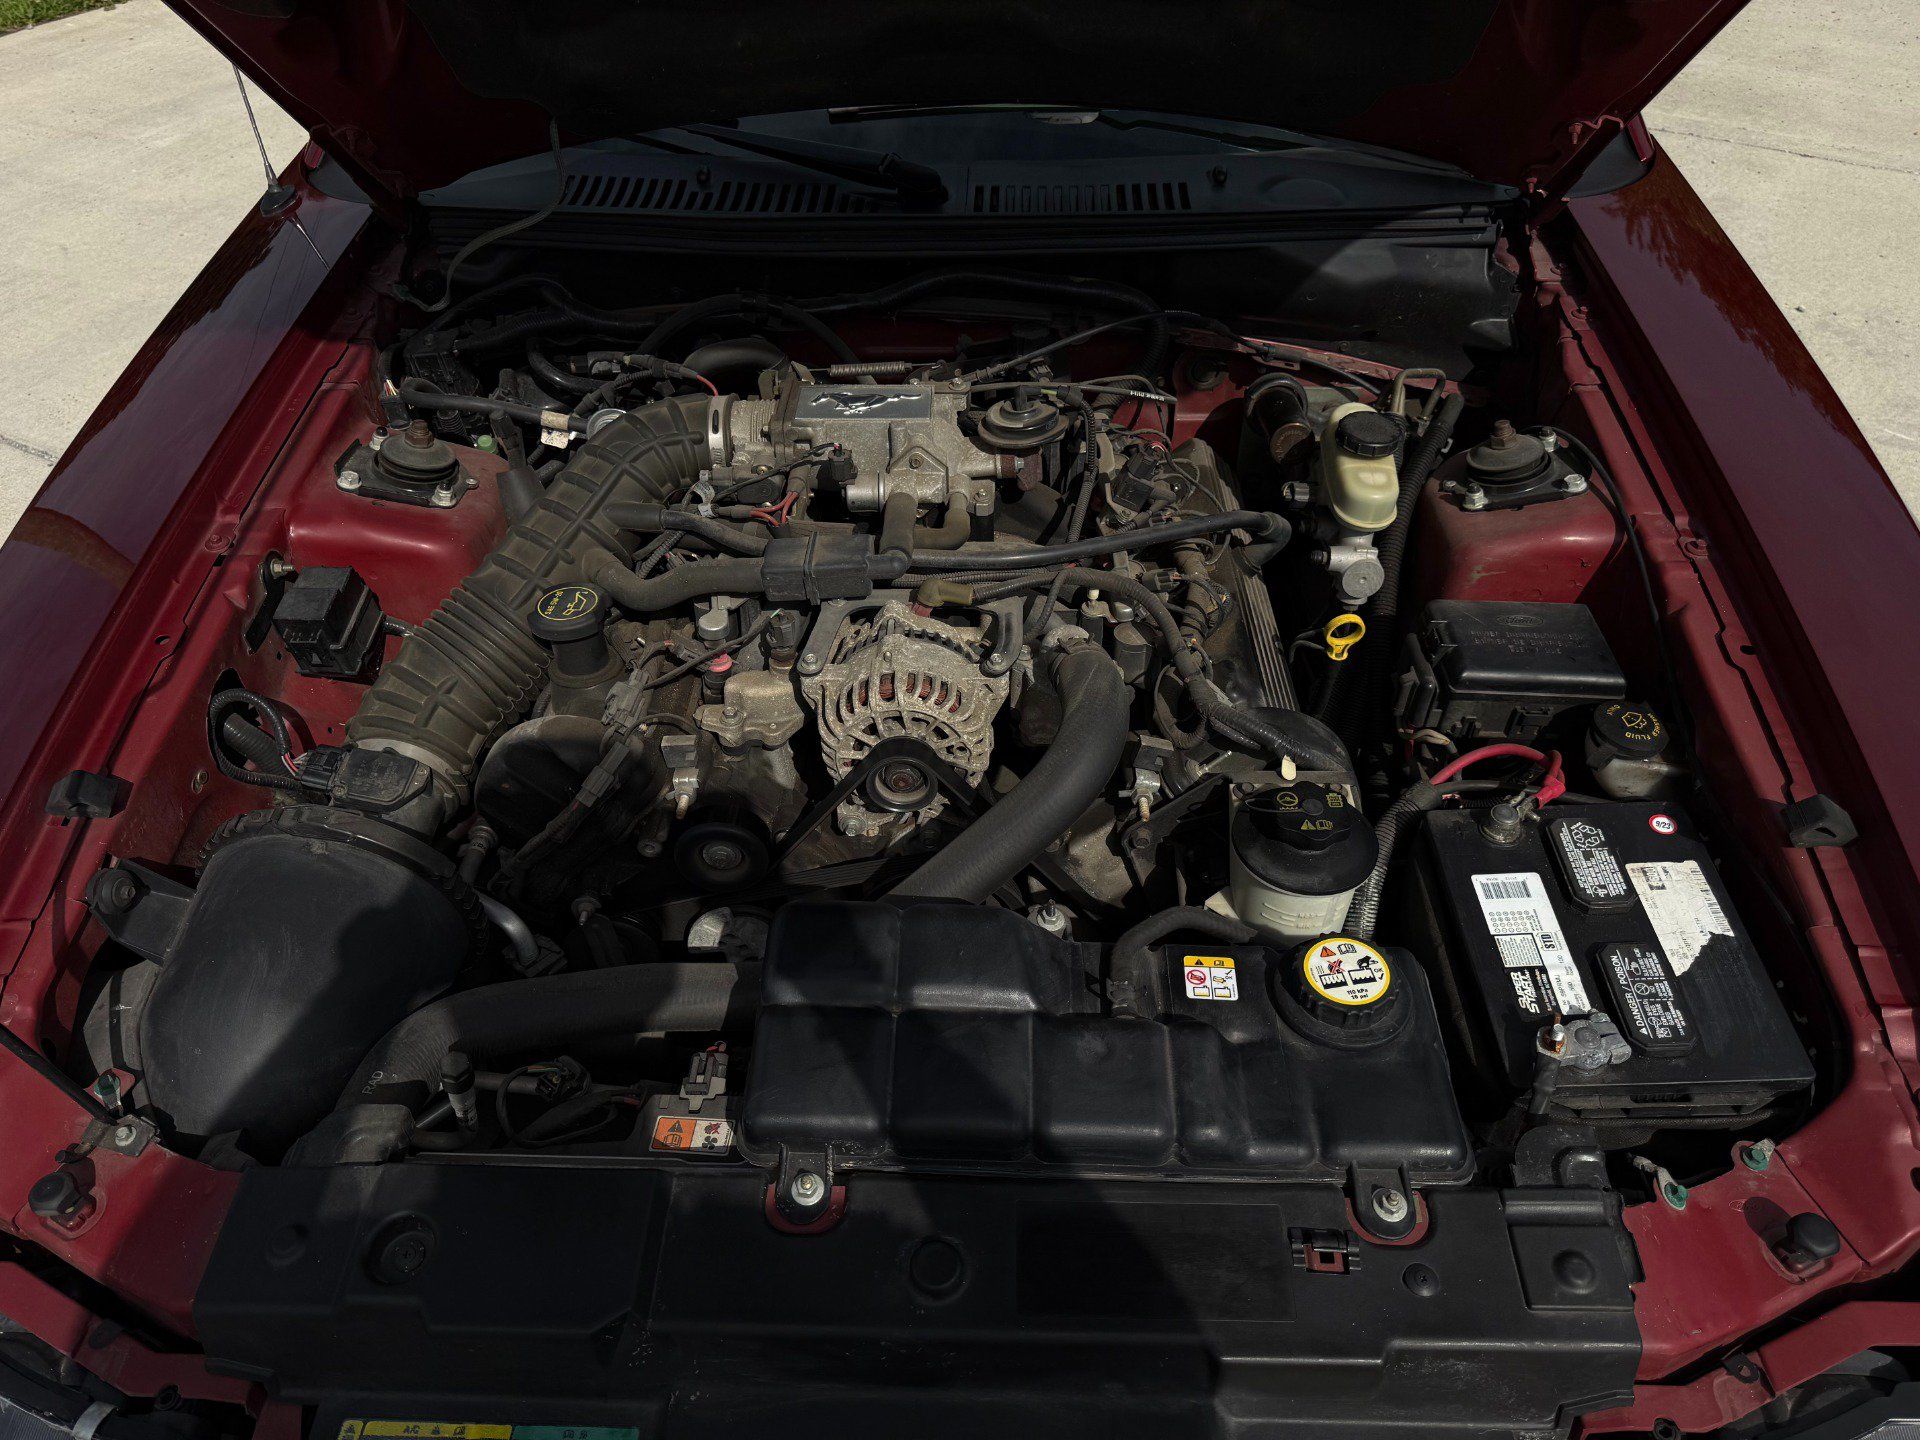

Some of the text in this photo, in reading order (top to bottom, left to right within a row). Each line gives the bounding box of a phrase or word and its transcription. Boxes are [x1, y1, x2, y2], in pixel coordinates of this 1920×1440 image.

[1606, 704, 1621, 716] ONLY
[1625, 731, 1652, 741] FLUID
[1655, 819, 1671, 831] 9/23
[1540, 933, 1555, 948] STD
[1610, 954, 1628, 984] POISON
[1510, 971, 1529, 1008] SUPER
[1518, 971, 1540, 1013] START
[1625, 992, 1644, 1026] DANGER
[361, 1070, 384, 1095] RAD
